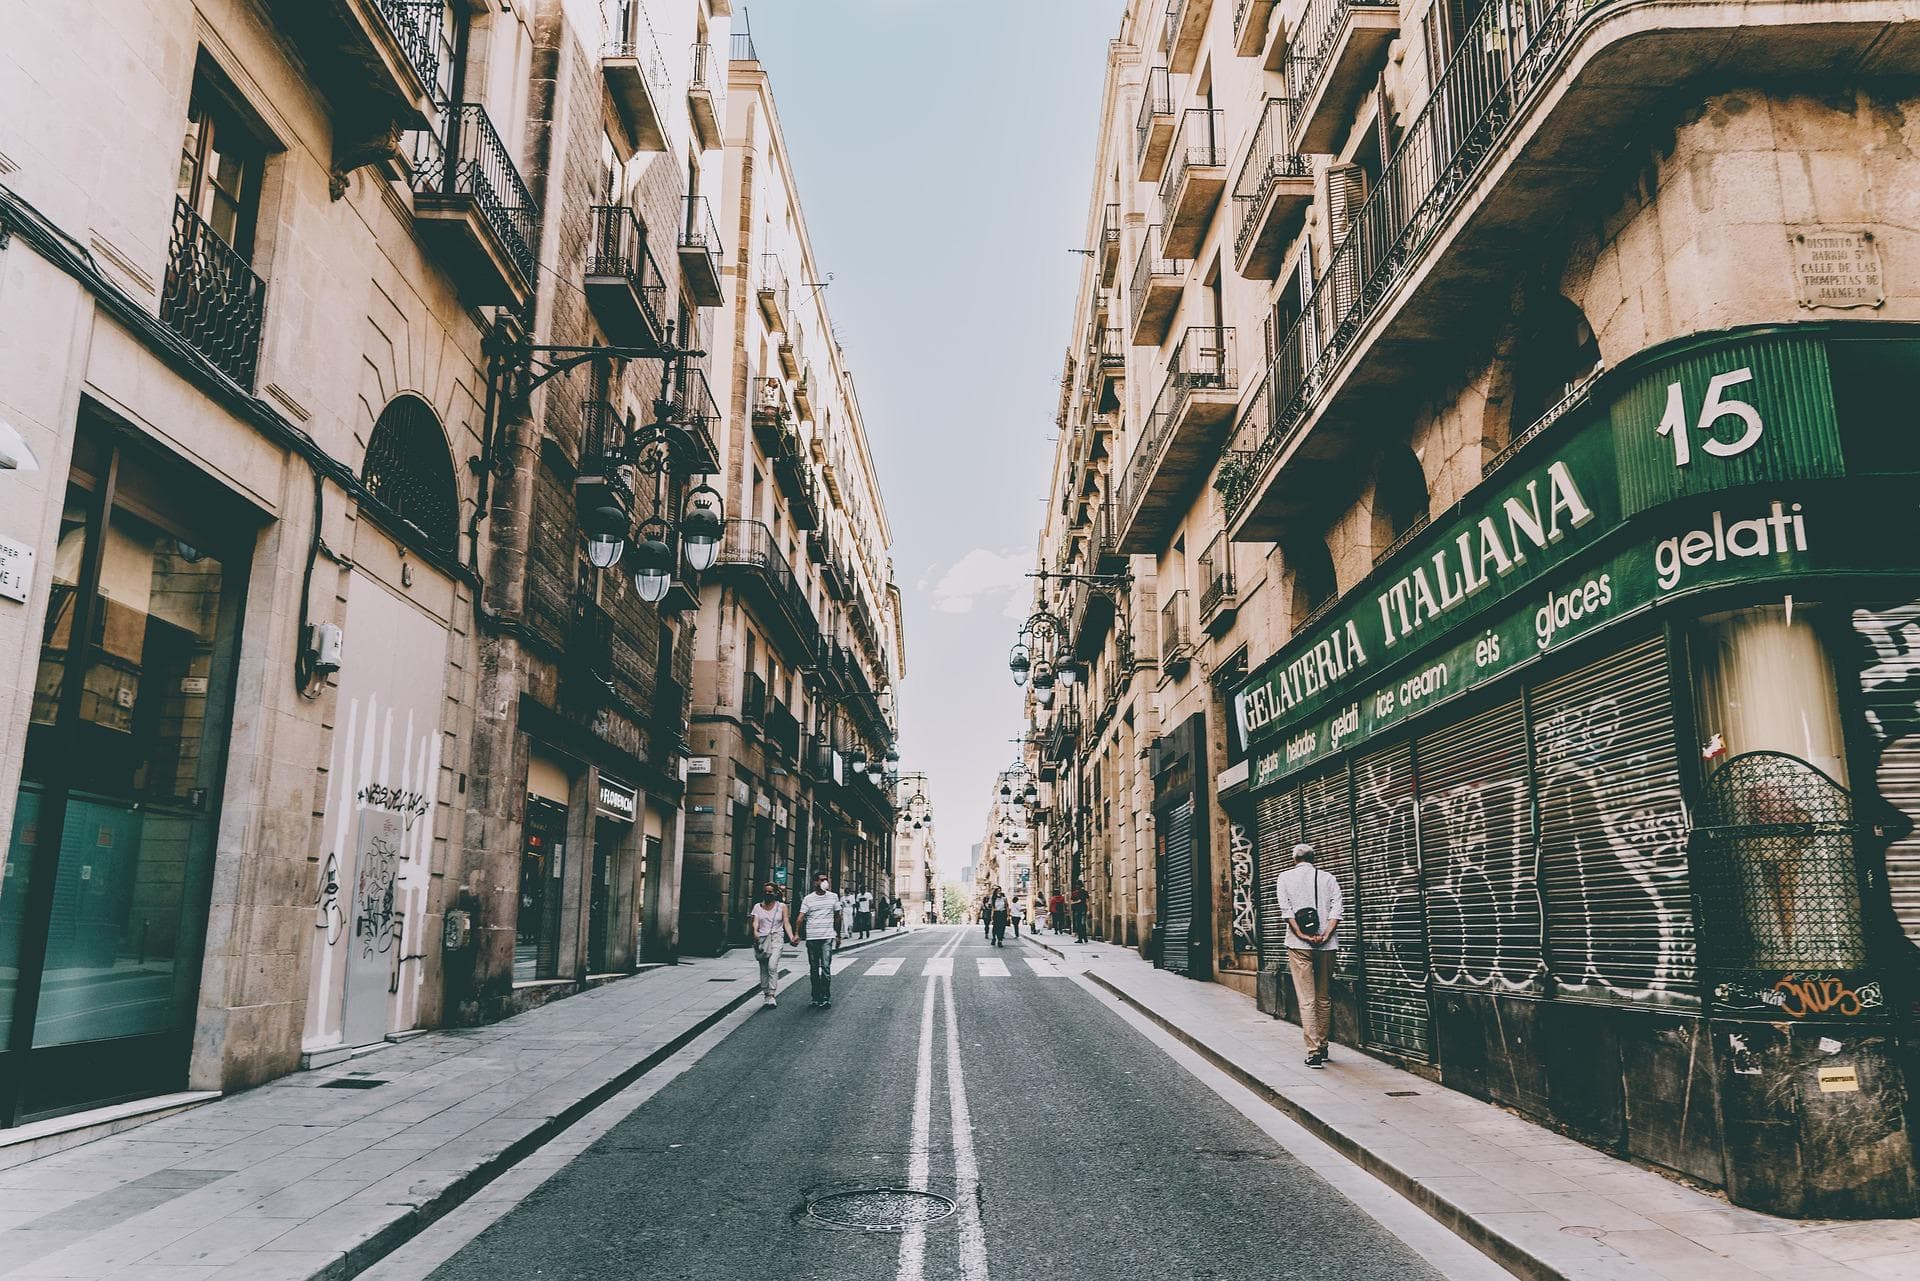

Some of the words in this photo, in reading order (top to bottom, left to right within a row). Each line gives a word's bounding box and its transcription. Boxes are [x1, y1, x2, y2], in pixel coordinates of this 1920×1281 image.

[1807, 238, 1853, 249] DISTRITO
[1812, 250, 1848, 261] BARRIO
[1801, 263, 1834, 274] CALLE
[1839, 262, 1851, 273] DE
[1857, 262, 1877, 273] LAS
[1804, 275, 1861, 286] TROMPETAS
[1866, 274, 1879, 286] DE
[1655, 366, 1764, 466] 15
[1243, 619, 1368, 734] GELATERIA
[1377, 460, 1595, 647] ITALIANA
[1286, 729, 1316, 764] helados
[1331, 702, 1359, 750] gelati
[1376, 690, 1395, 719] ice
[1399, 662, 1448, 707] cream
[1475, 629, 1500, 668] eis
[1535, 573, 1612, 649] glaces
[1655, 501, 1808, 590] gelati
